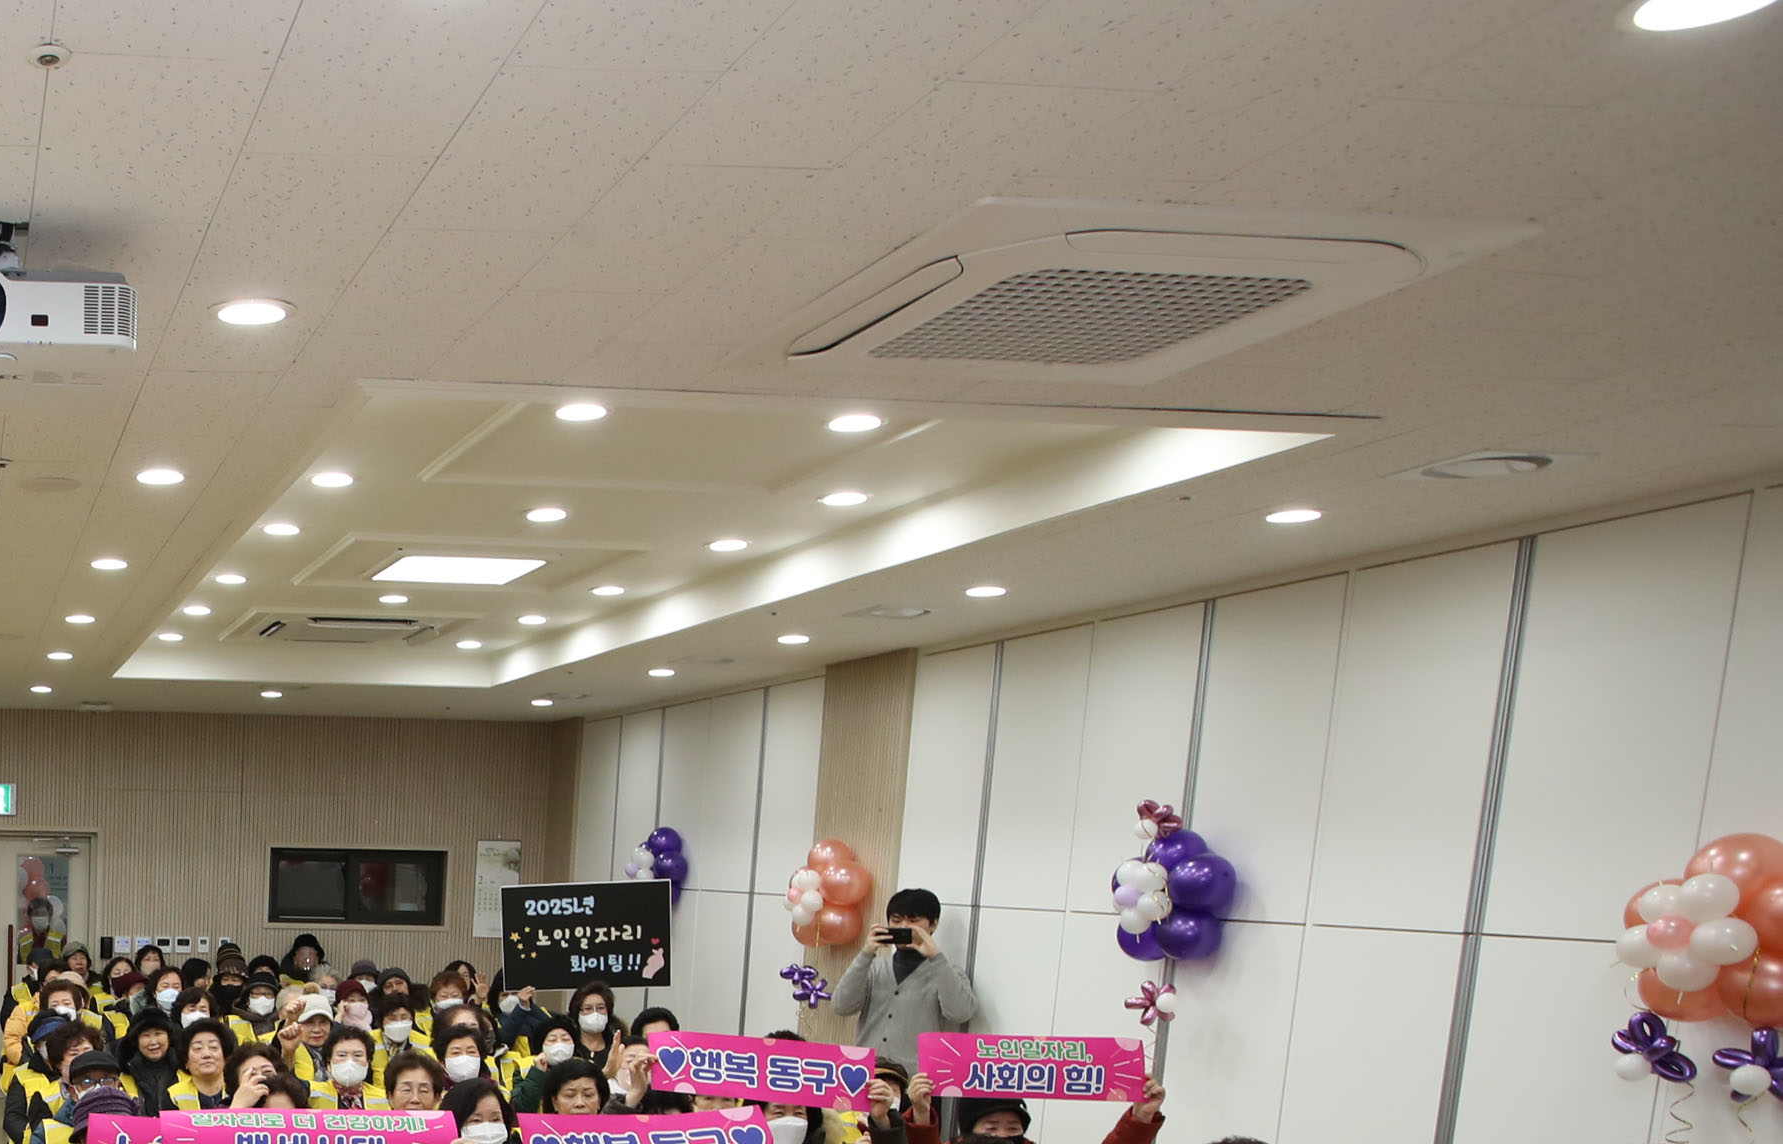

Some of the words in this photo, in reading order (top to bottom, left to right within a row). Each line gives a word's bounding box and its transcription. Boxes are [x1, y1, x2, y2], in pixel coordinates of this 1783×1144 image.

[524, 896, 595, 916] 2025년
[536, 924, 642, 950] 노인일자리
[977, 1039, 1093, 1063] 노인일자리,
[689, 1047, 758, 1089] 행복
[766, 1055, 838, 1095] 동구
[963, 1061, 1056, 1093] 사회의
[1063, 1063, 1105, 1095] 힘!
[190, 1112, 285, 1130] 일자리로
[293, 1113, 316, 1131] 더
[323, 1113, 427, 1134] 건강하게!
